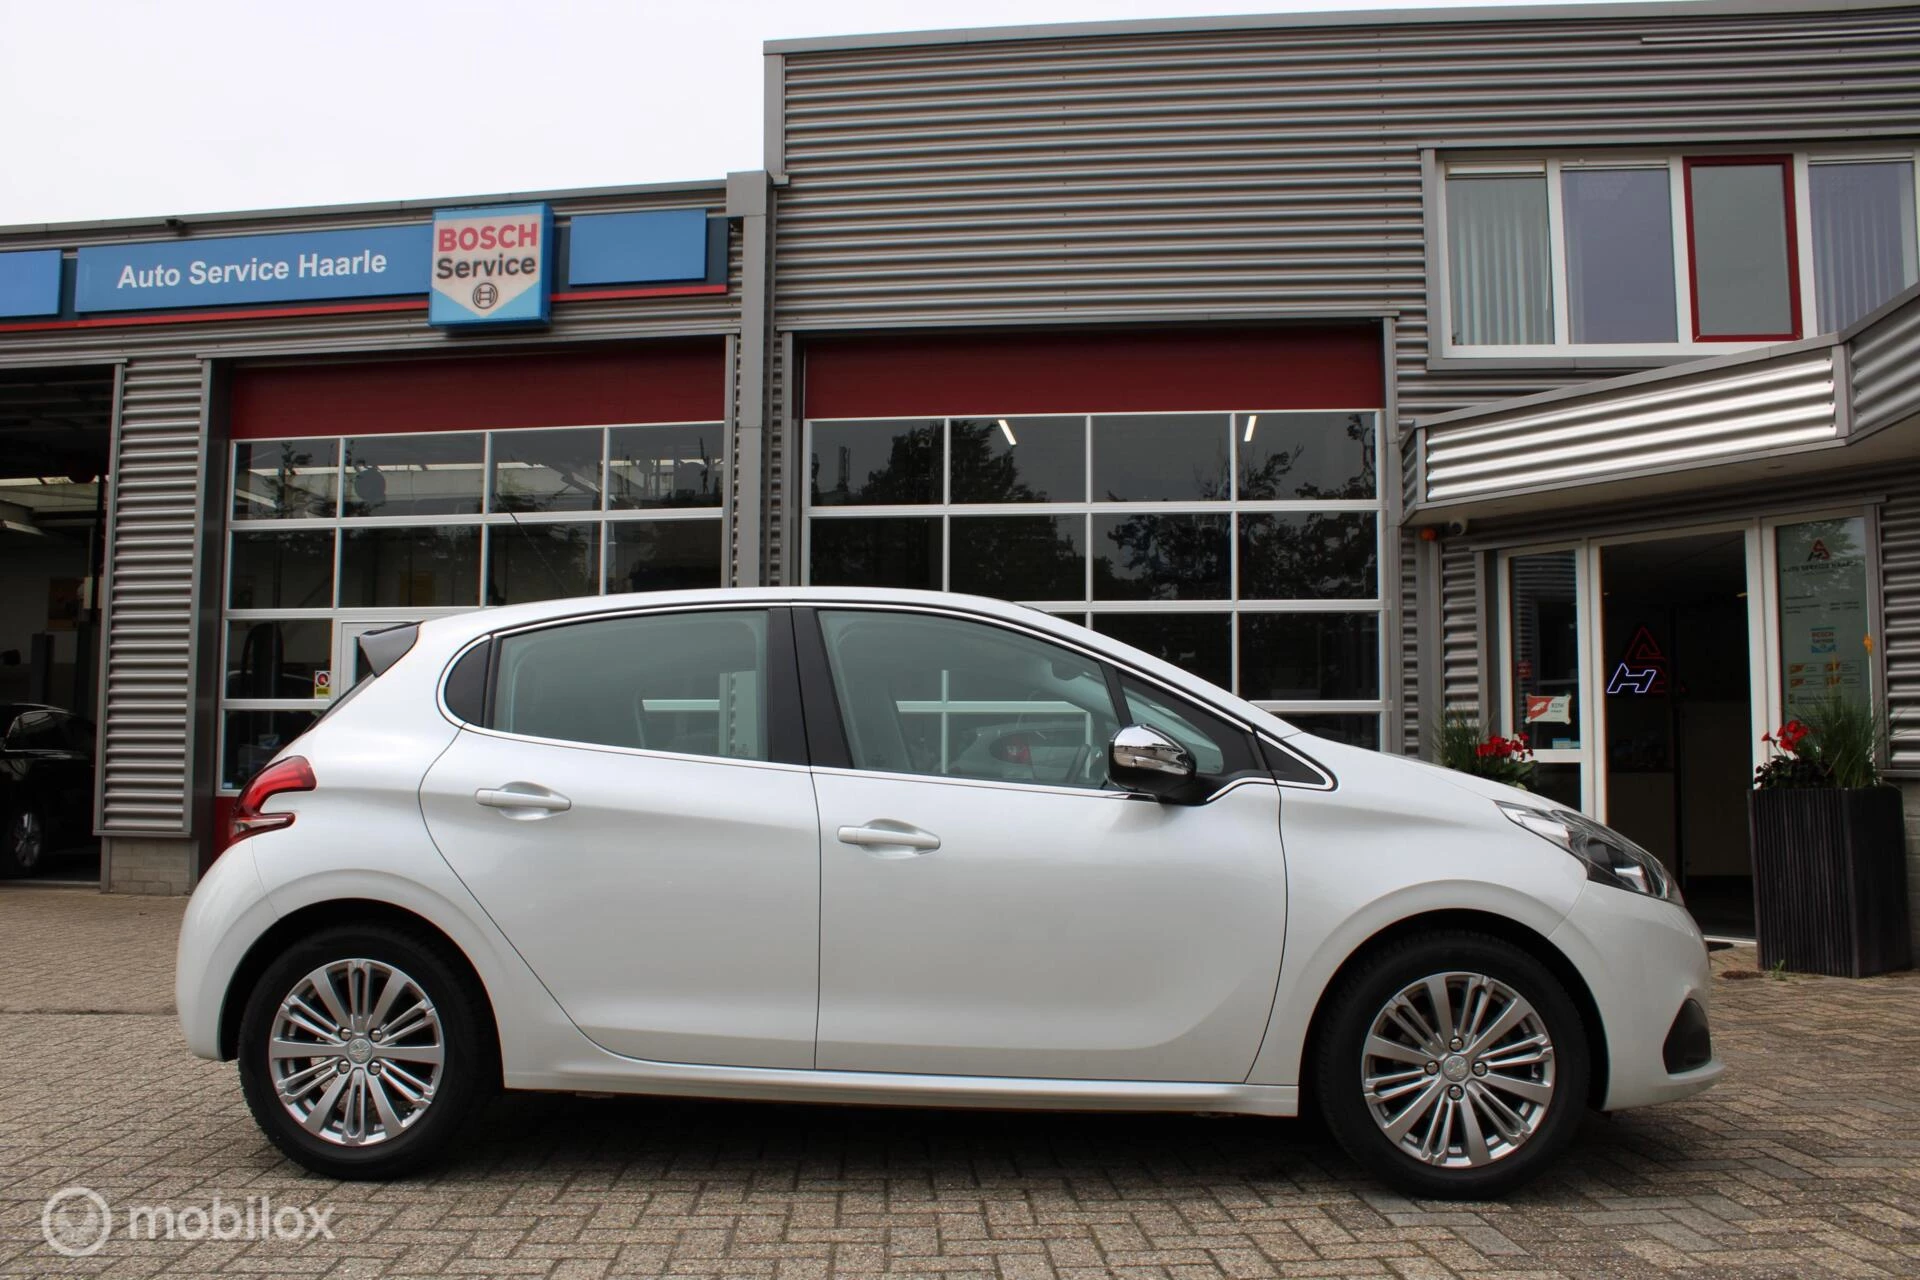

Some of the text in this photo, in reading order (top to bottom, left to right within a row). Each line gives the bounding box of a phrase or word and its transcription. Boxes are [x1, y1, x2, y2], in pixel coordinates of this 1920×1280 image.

[438, 223, 538, 252] BOSCH
[117, 250, 387, 289] Auto Service Haarle
[436, 252, 536, 279] Service
